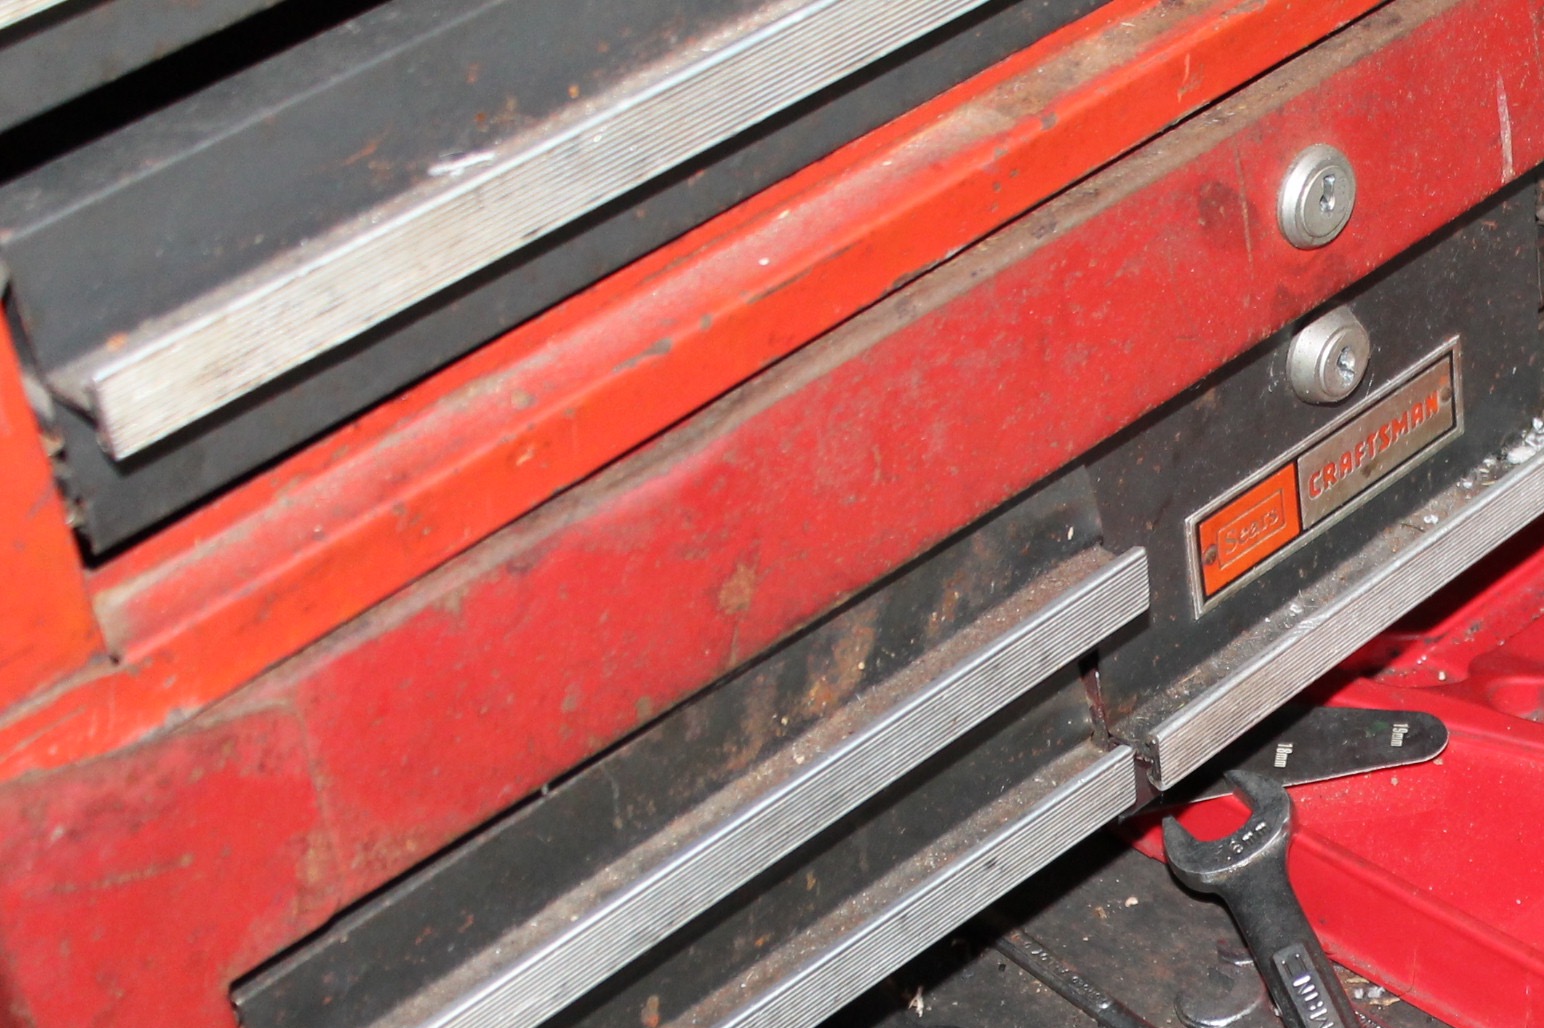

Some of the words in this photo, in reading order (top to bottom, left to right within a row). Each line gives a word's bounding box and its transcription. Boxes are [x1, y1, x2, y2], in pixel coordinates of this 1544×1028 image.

[1224, 506, 1279, 553] Sears
[1308, 391, 1440, 500] CRAFTSMAN
[1390, 723, 1409, 747] 19mm
[1274, 743, 1293, 768] 18mm
